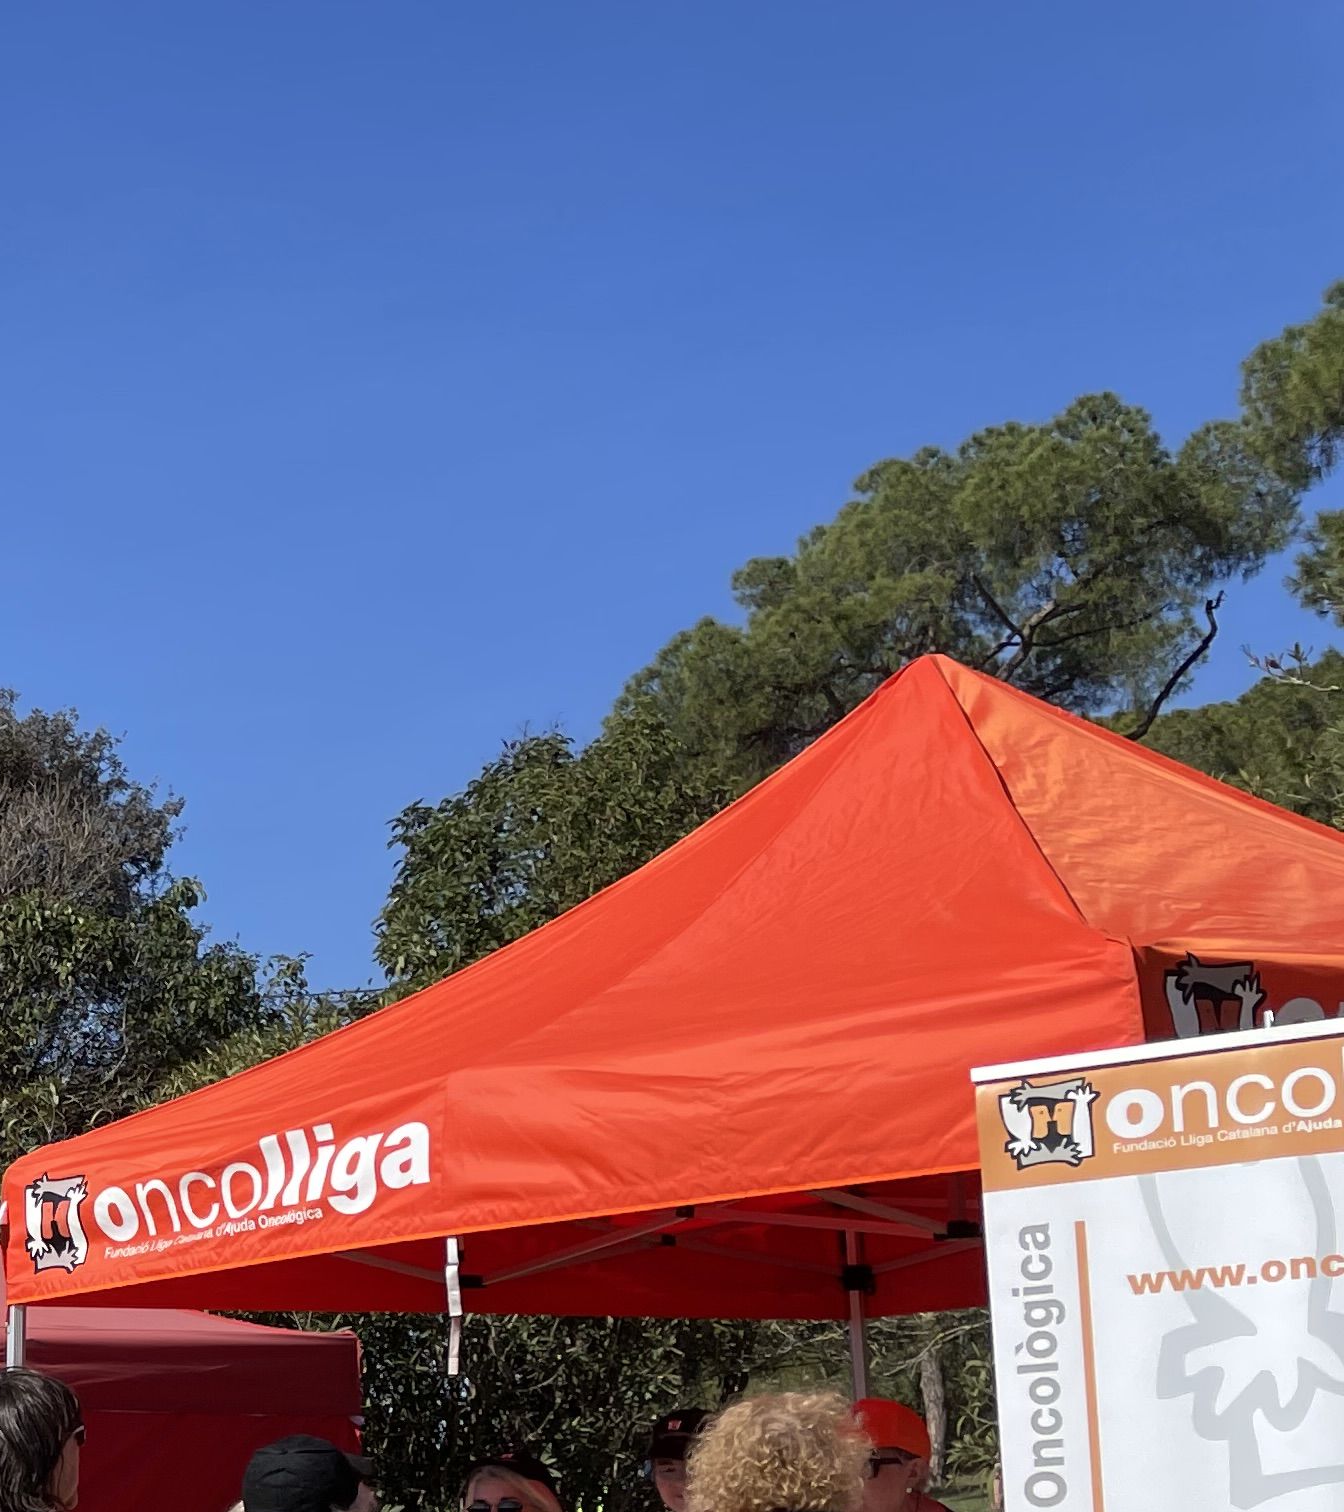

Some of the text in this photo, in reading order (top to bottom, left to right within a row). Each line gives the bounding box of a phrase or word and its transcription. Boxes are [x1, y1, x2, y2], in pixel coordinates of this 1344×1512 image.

[1106, 1047, 1344, 1139] onco
[1113, 1138, 1176, 1154] Fundació
[1181, 1132, 1213, 1148] Lliga
[1218, 1126, 1278, 1142] Catalana
[94, 1122, 431, 1241] oncolliga
[1011, 1223, 1068, 1508] Oncològica
